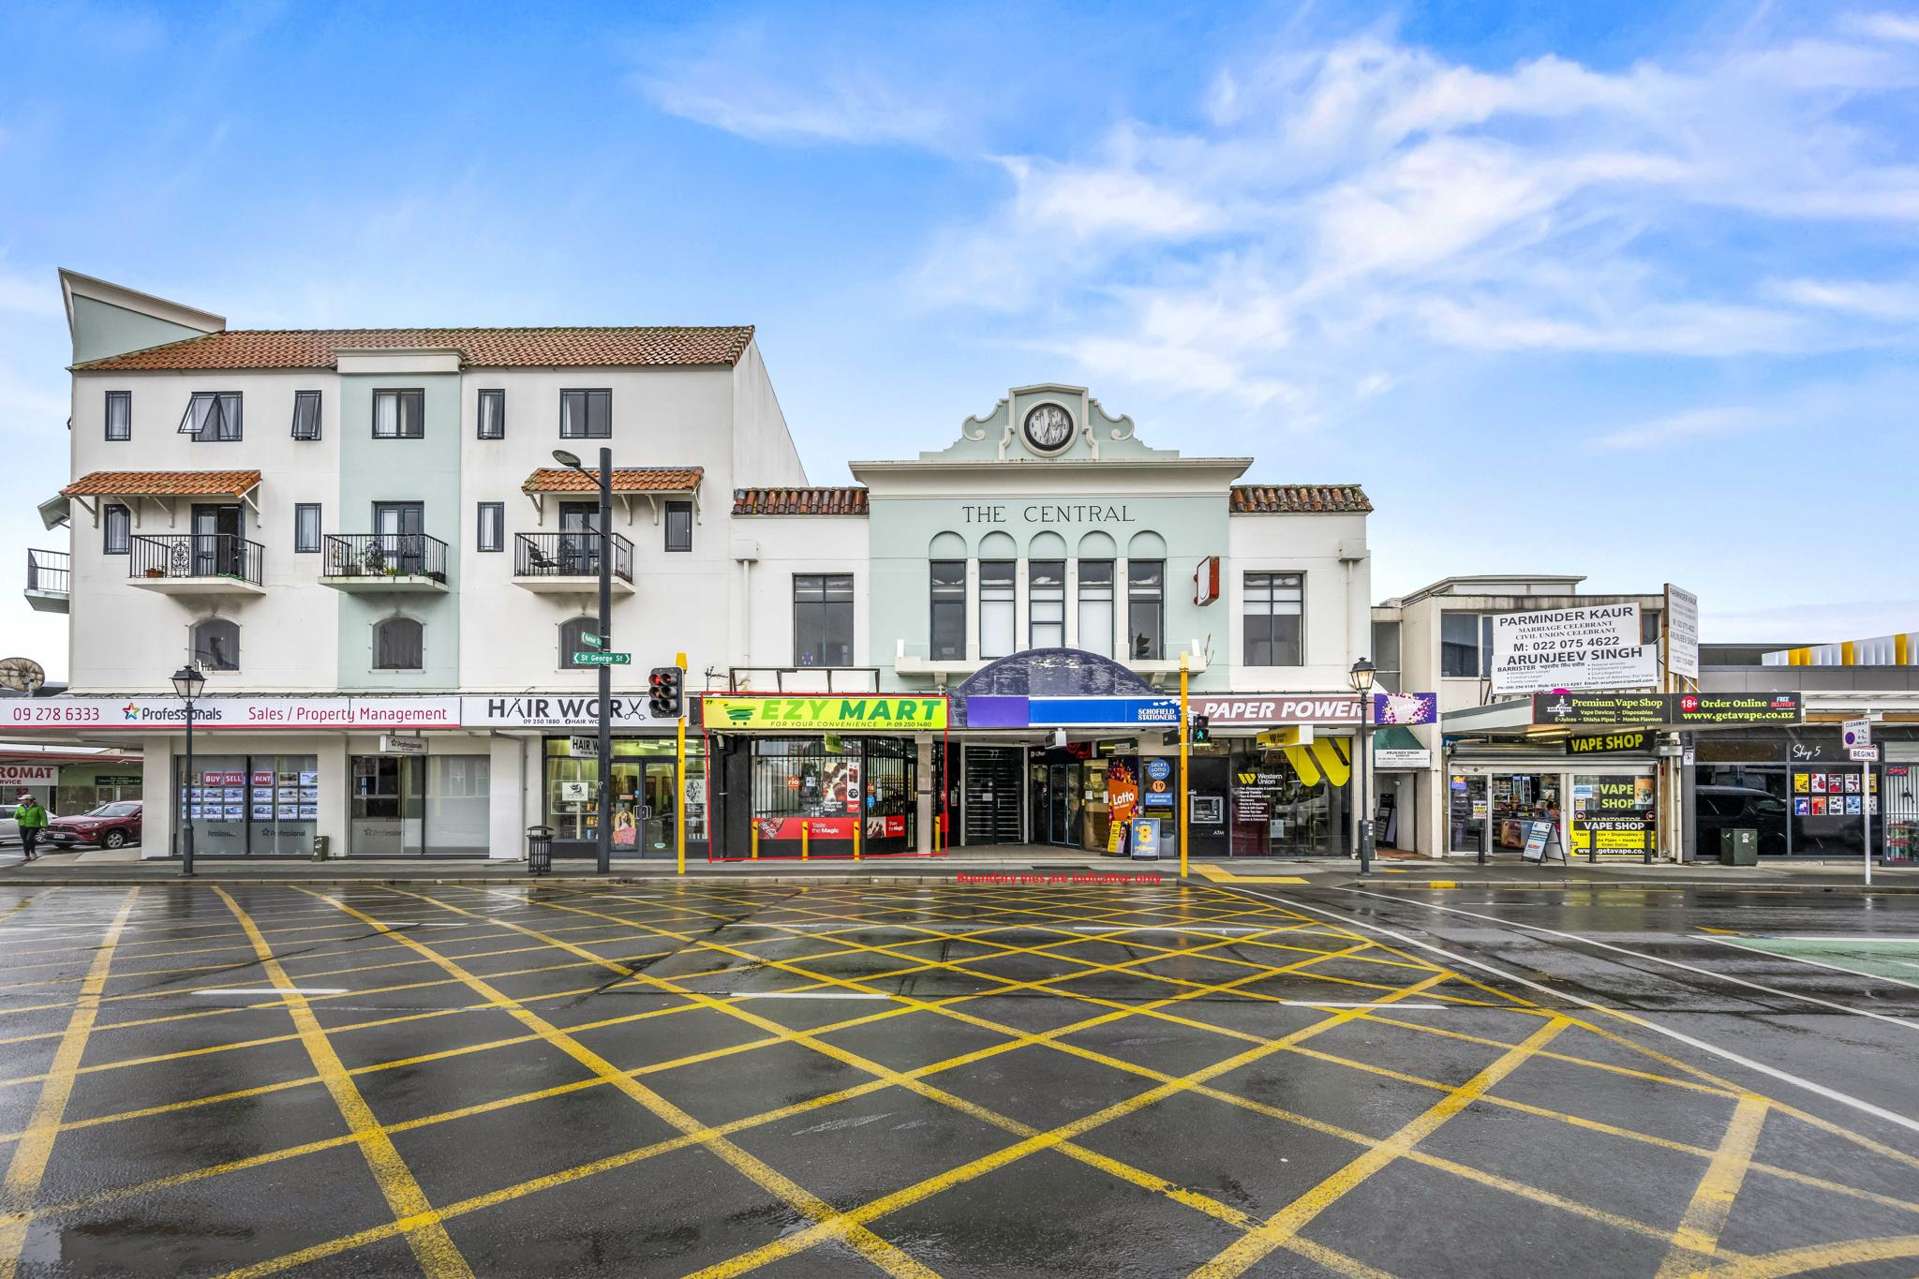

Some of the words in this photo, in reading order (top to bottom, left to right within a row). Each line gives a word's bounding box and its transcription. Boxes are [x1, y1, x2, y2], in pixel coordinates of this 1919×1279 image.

[962, 506, 1007, 522] THE
[1024, 505, 1136, 522] CENTRAL
[1500, 610, 1585, 627] PARMINDER
[1589, 607, 1633, 620] KAUR
[1516, 632, 1538, 640] CIVIL
[1540, 630, 1564, 639] UNION
[1566, 627, 1616, 637] CELEBRANT
[1518, 624, 1562, 633] MARRIAGE
[1564, 620, 1613, 630] CELEBRANT
[1513, 642, 1528, 652] M:
[1533, 640, 1556, 651] 022
[1560, 638, 1583, 649] 075
[1587, 636, 1620, 646] 4622
[1507, 650, 1586, 666] ARUNJEEV
[1591, 647, 1642, 660] SINGH
[1497, 664, 1536, 672] BARRISTER
[488, 698, 550, 718] HAIR
[761, 700, 832, 720] EZY
[839, 700, 942, 720] MART
[1202, 702, 1275, 719] PAPER
[1280, 701, 1364, 718] POWER
[1572, 698, 1614, 707] Premium
[1615, 698, 1638, 708] Vape
[1639, 698, 1663, 708] Shop
[1681, 700, 1697, 708] 18+
[1701, 699, 1730, 708] Order
[1732, 698, 1767, 707] Online
[14, 707, 30, 721] 09
[36, 707, 60, 721] 278
[66, 707, 100, 721] 6333
[142, 706, 222, 720] Professonals
[249, 706, 284, 720] Sales
[297, 707, 354, 723] Property
[360, 707, 447, 723] Management
[1682, 712, 1795, 721] www.getavape.co.nz
[573, 738, 590, 750] HAIR
[1571, 737, 1603, 752] VAPE
[1606, 734, 1644, 750] SHOP
[1600, 784, 1633, 794] VAPE
[1112, 792, 1134, 804] Lotto
[1602, 799, 1635, 808] SHOP
